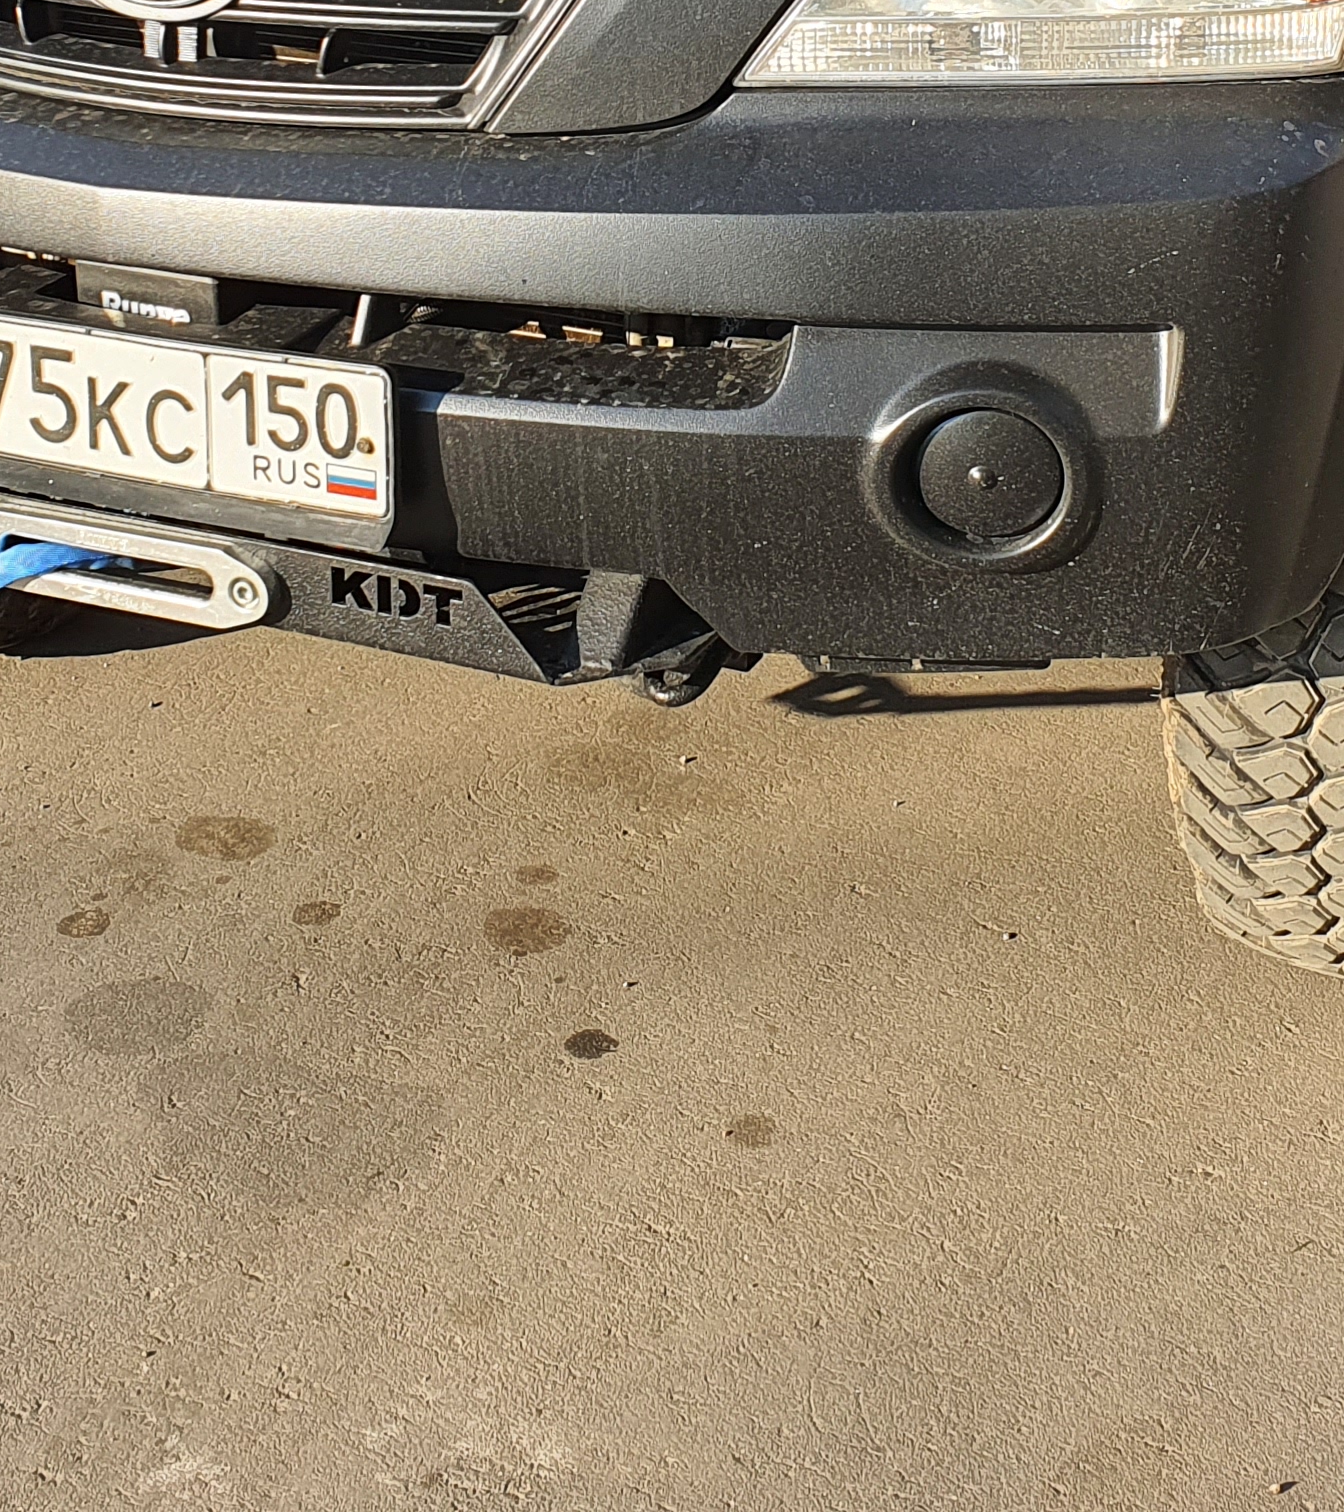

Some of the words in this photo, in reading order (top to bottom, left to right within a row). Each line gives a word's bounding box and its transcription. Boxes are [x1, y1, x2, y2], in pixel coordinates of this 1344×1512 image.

[221, 370, 358, 460] 150
[253, 454, 321, 489] RUS
[331, 567, 463, 626] KDT
